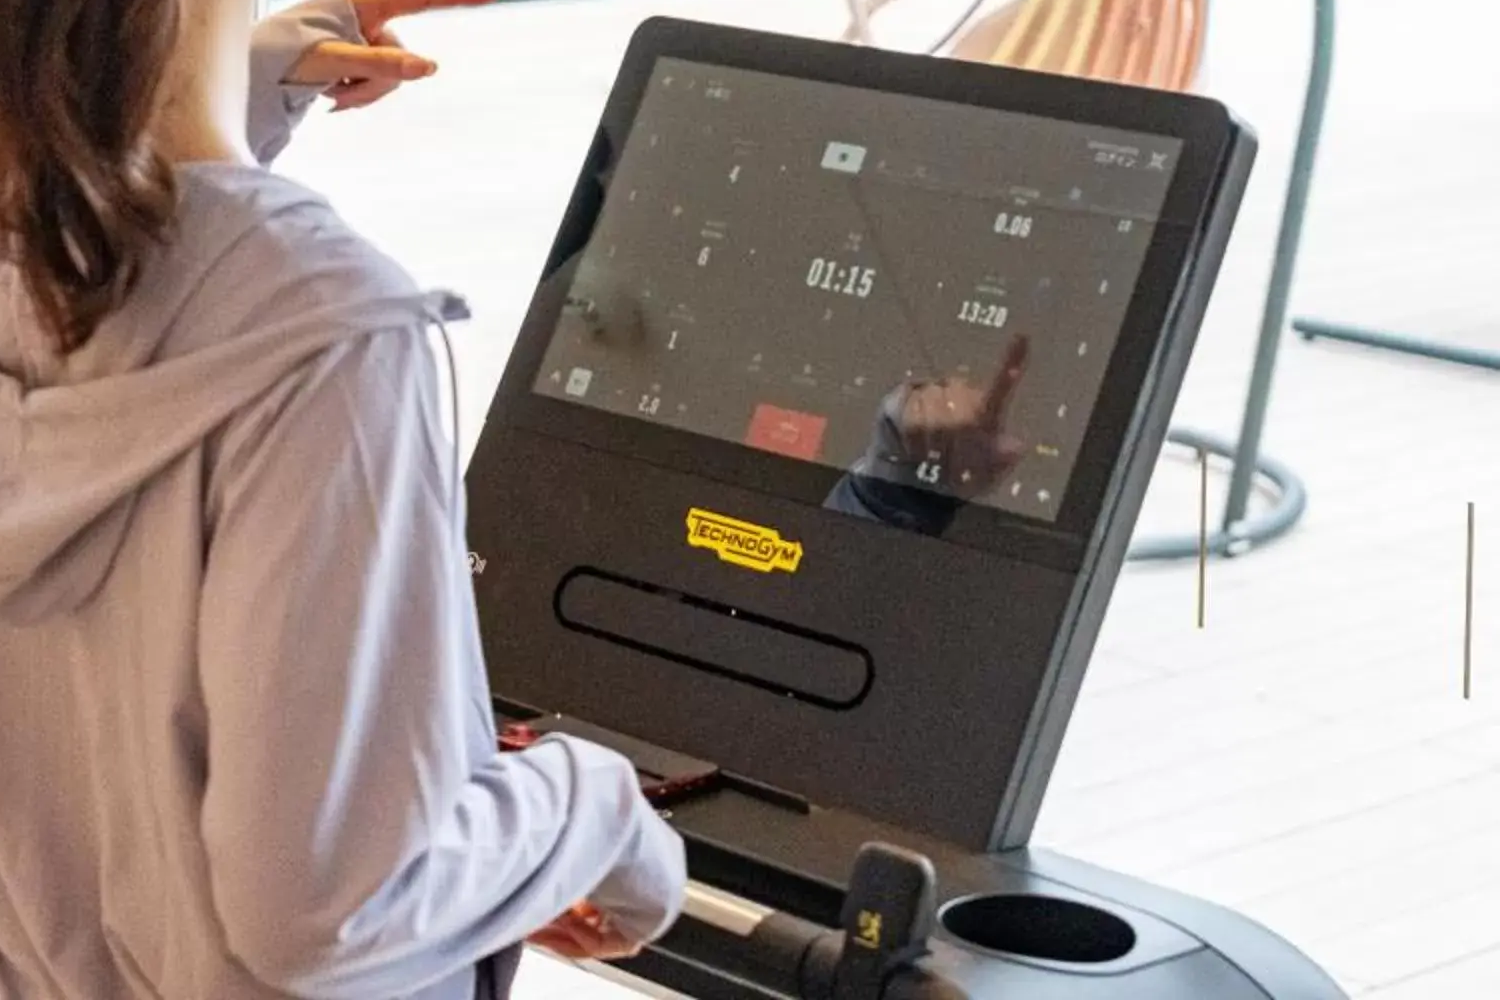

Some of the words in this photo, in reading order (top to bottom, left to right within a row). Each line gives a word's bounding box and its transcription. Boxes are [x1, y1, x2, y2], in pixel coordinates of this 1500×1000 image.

[806, 257, 877, 298] 01:15
[957, 300, 1008, 328] 13:20
[689, 511, 799, 564] TECHNOGYM
